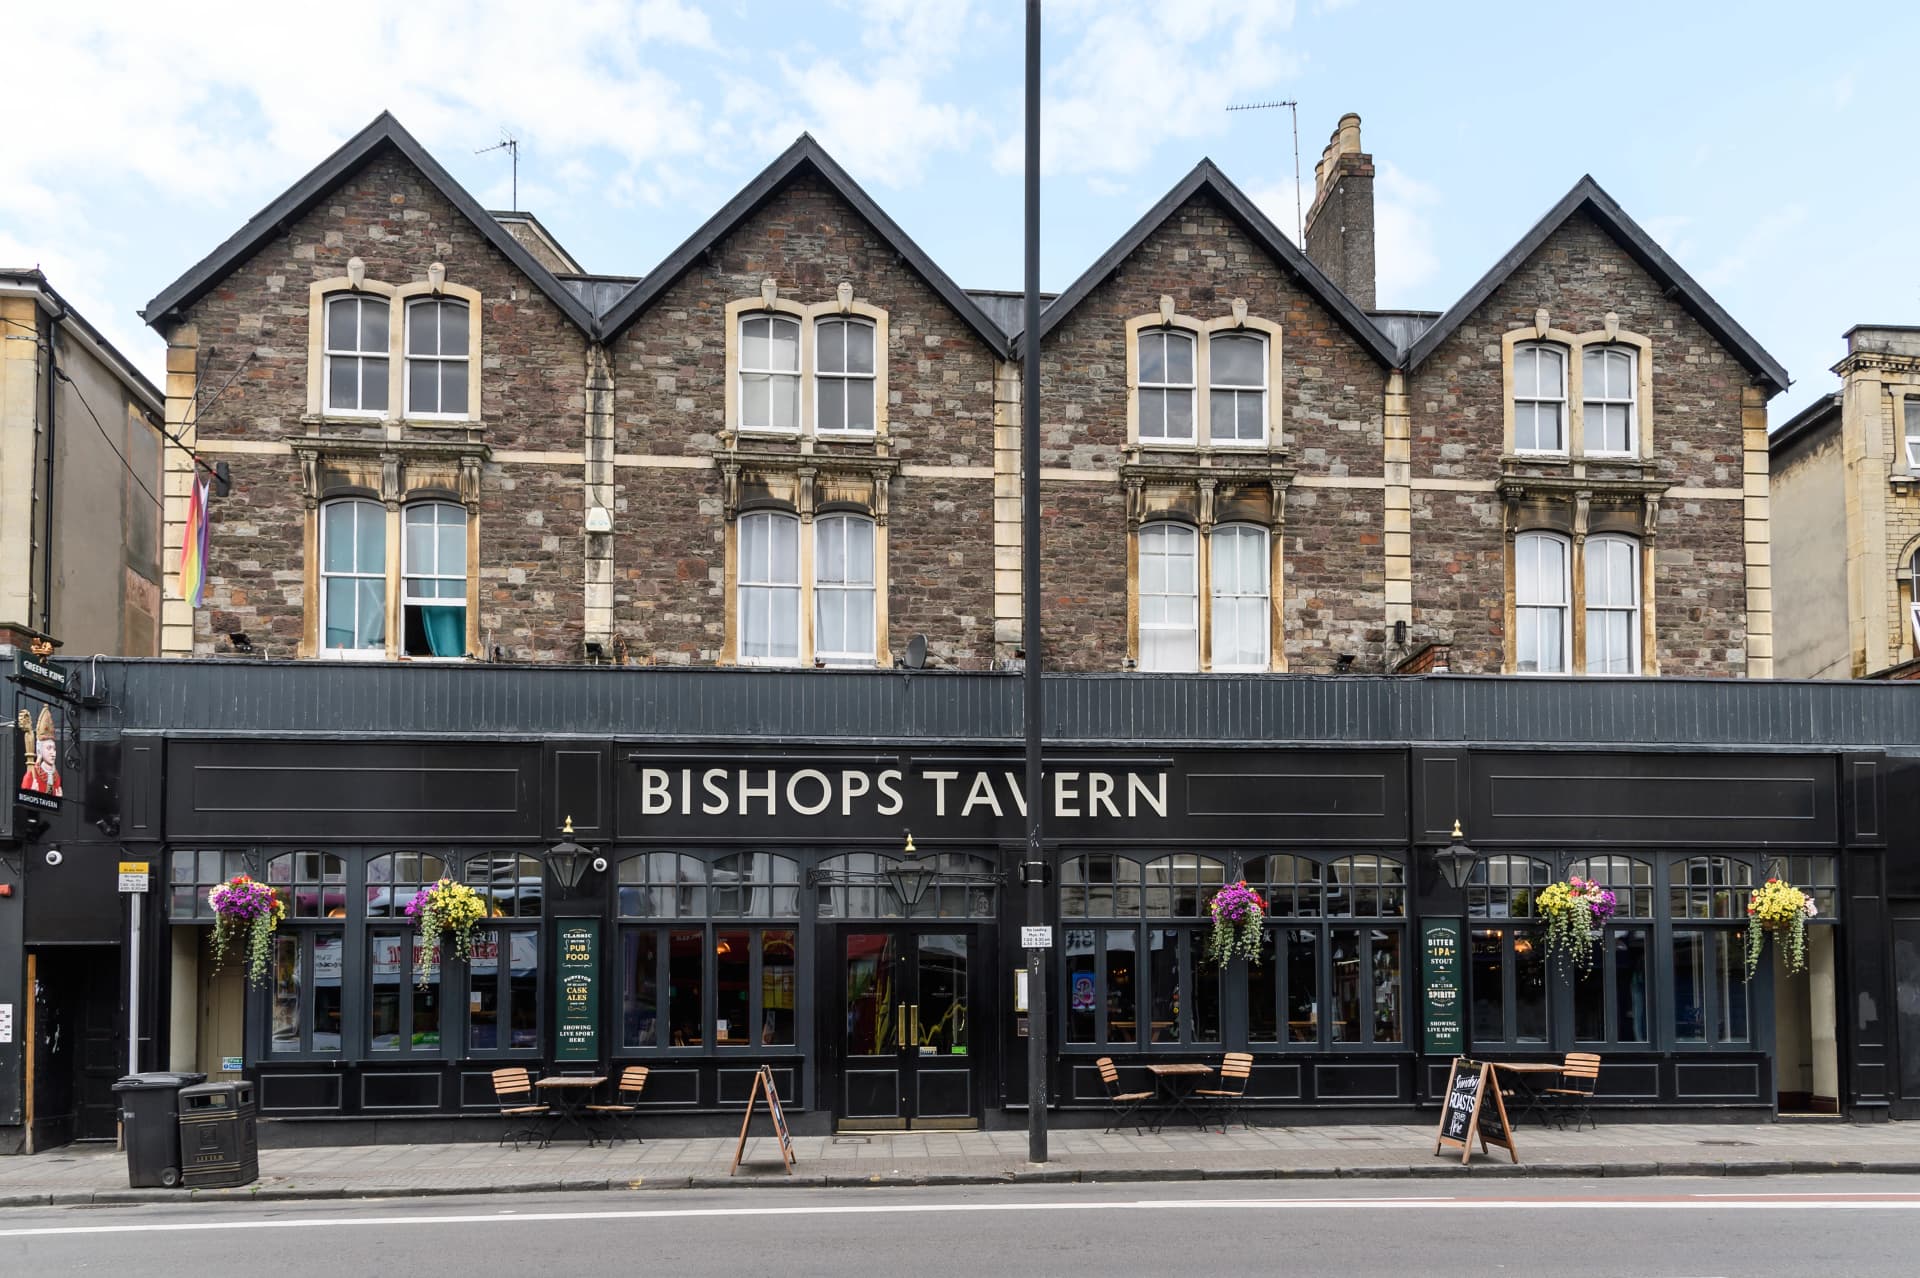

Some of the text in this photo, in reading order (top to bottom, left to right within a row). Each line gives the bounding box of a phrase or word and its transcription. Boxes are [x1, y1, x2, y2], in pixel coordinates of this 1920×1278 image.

[23, 660, 49, 677] GREENE
[48, 670, 65, 683] KING
[642, 768, 1168, 817] BISHOPS TAVERN
[18, 793, 58, 808] BISHOPS TAVERN
[1427, 938, 1454, 946] BITTER
[1434, 947, 1450, 956] IPA
[565, 953, 590, 961] FOOD
[566, 986, 588, 994] CASK
[1428, 990, 1456, 999] SPIRITS
[1449, 1091, 1477, 1113] ROASTS
